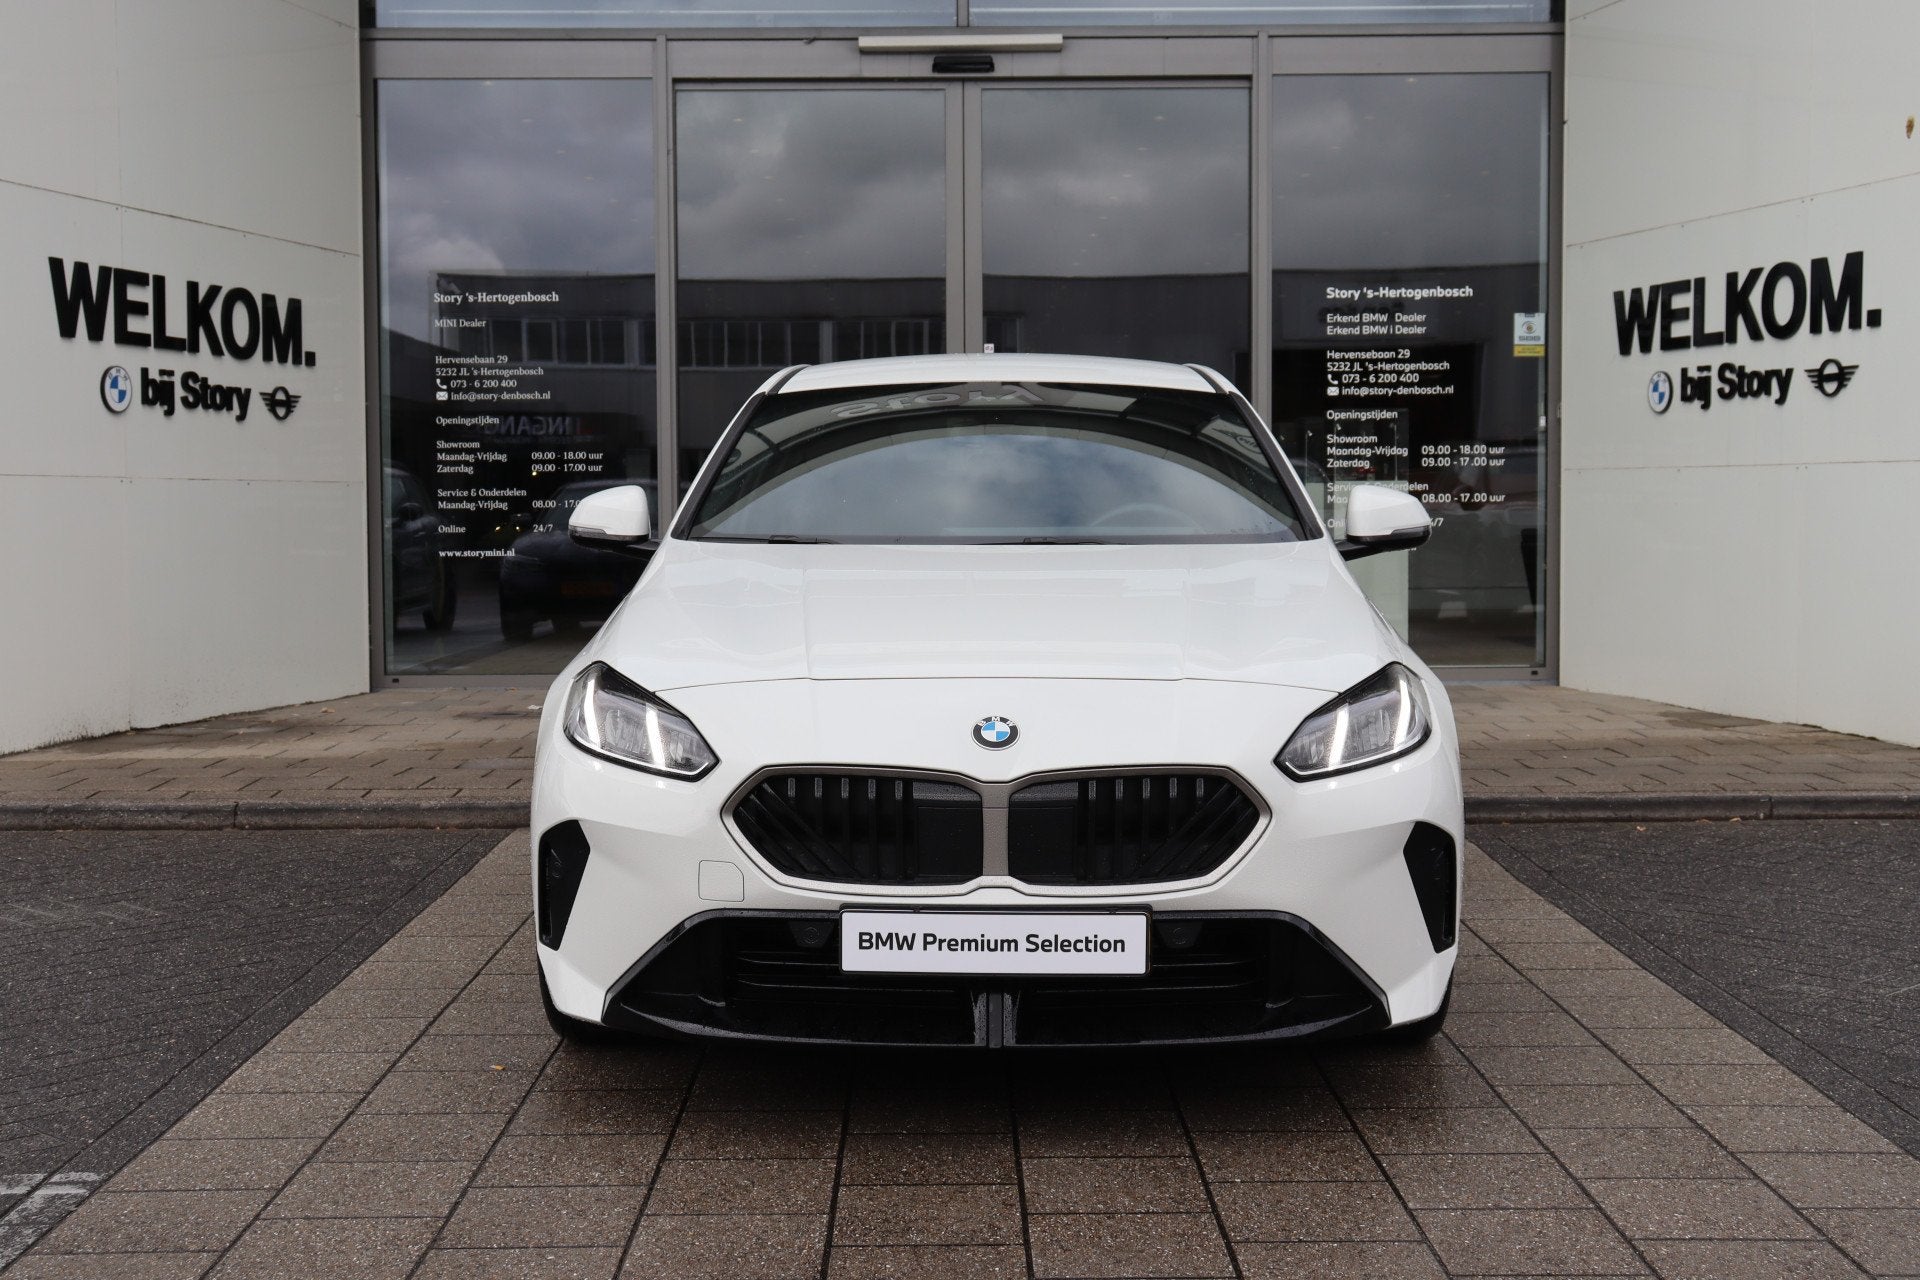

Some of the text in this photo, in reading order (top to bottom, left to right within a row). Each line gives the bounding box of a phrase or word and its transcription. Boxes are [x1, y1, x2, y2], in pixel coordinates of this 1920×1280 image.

[434, 291, 559, 305] Story 's-Hertogenbosch
[1326, 285, 1473, 300] Story 's-Hertogenbosch
[1613, 250, 1882, 356] WELKOM.
[48, 256, 316, 367] WELKOM.
[434, 319, 486, 328] MINI Dealer
[1327, 313, 1427, 323] Erkend BMW Dealer
[1327, 325, 1360, 335] Erkend
[1362, 325, 1389, 335] BMW
[1395, 325, 1427, 334] Dealer
[435, 355, 508, 364] Hervensebaan 29
[1327, 349, 1411, 359] Hervensebaan 29
[435, 367, 544, 377] 5232 JL 's-Hertogenbosch
[1327, 361, 1450, 372] 5232 JL 's-Hertogenbosch
[450, 379, 467, 388] 073
[474, 379, 479, 388] 6
[482, 379, 498, 388] 200
[500, 379, 517, 388] 400
[1342, 374, 1360, 384] 073
[1369, 374, 1375, 383] 6
[1378, 374, 1397, 383] 200
[1399, 373, 1419, 383] 400
[1342, 385, 1454, 396] info@story-denbosch.nl
[1680, 362, 1794, 411] bij Story
[141, 367, 251, 422] bij Story
[451, 391, 551, 402] info@story-denbosch.nl
[436, 415, 499, 426] Openingstijden
[1327, 409, 1398, 421] Openingstijden
[1326, 434, 1378, 443] Showroom
[436, 440, 480, 449] Showroom
[437, 452, 508, 462] Maandag-Vrijdag
[531, 452, 555, 460] 09.00
[563, 451, 586, 460] 18.00
[1327, 446, 1408, 457] Maandag-Vrijdag
[1421, 445, 1451, 455] 09.00
[1460, 445, 1487, 454] 18.00
[1489, 446, 1505, 454] uur
[1327, 459, 1370, 469] Zaterdag
[1421, 457, 1451, 467] 09.00
[1489, 459, 1505, 467] uur
[437, 464, 474, 475] Zaterdag
[531, 464, 555, 472] 09.00
[563, 464, 586, 472] 17.00
[438, 488, 468, 497] Service
[479, 488, 527, 497] Onderdelen
[1422, 493, 1451, 503] 08.00
[1489, 494, 1505, 502] uur
[438, 500, 508, 510] Maandag-Vrijdag
[532, 500, 556, 509] 08.00
[438, 524, 553, 533] Online 24/7
[439, 548, 515, 558] www.storymini.nl
[858, 932, 1126, 954] BMW Premium Selection
